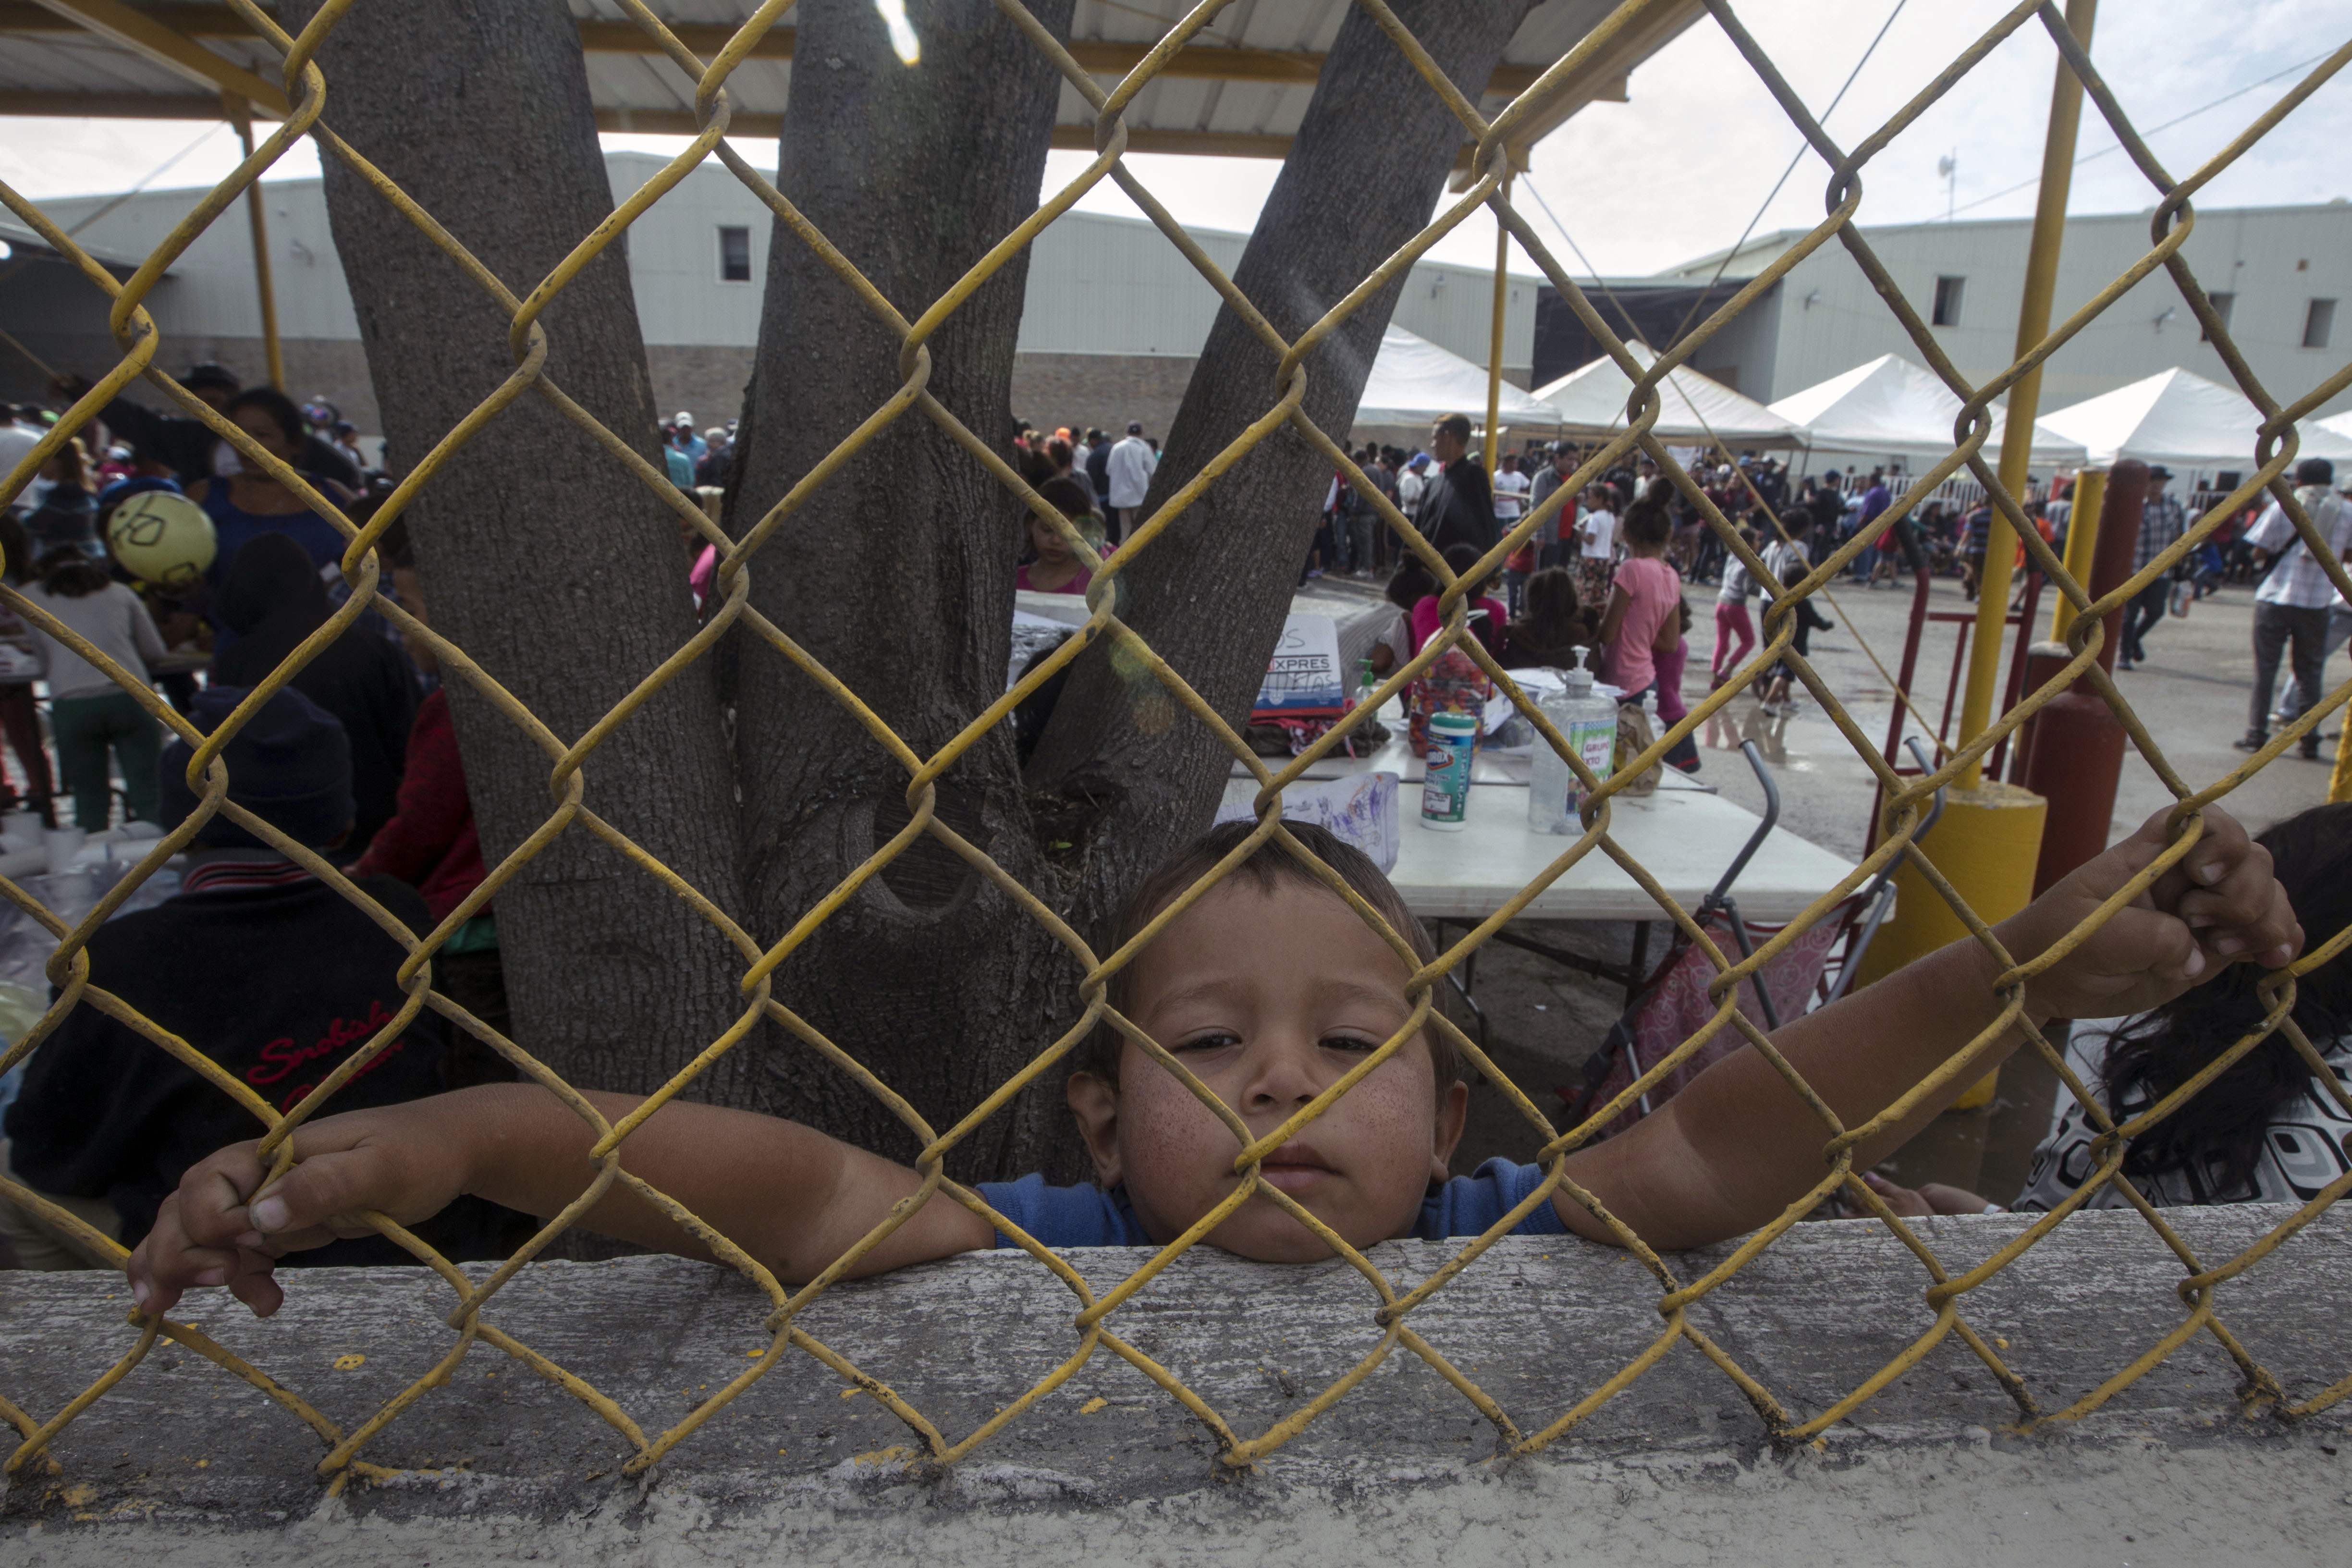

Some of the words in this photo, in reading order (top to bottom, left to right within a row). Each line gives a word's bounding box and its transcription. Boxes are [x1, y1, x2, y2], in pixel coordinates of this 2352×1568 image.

[1269, 658, 1330, 670] XPRES
[1426, 750, 1451, 764] ROX
[1583, 756, 1600, 766] XTO
